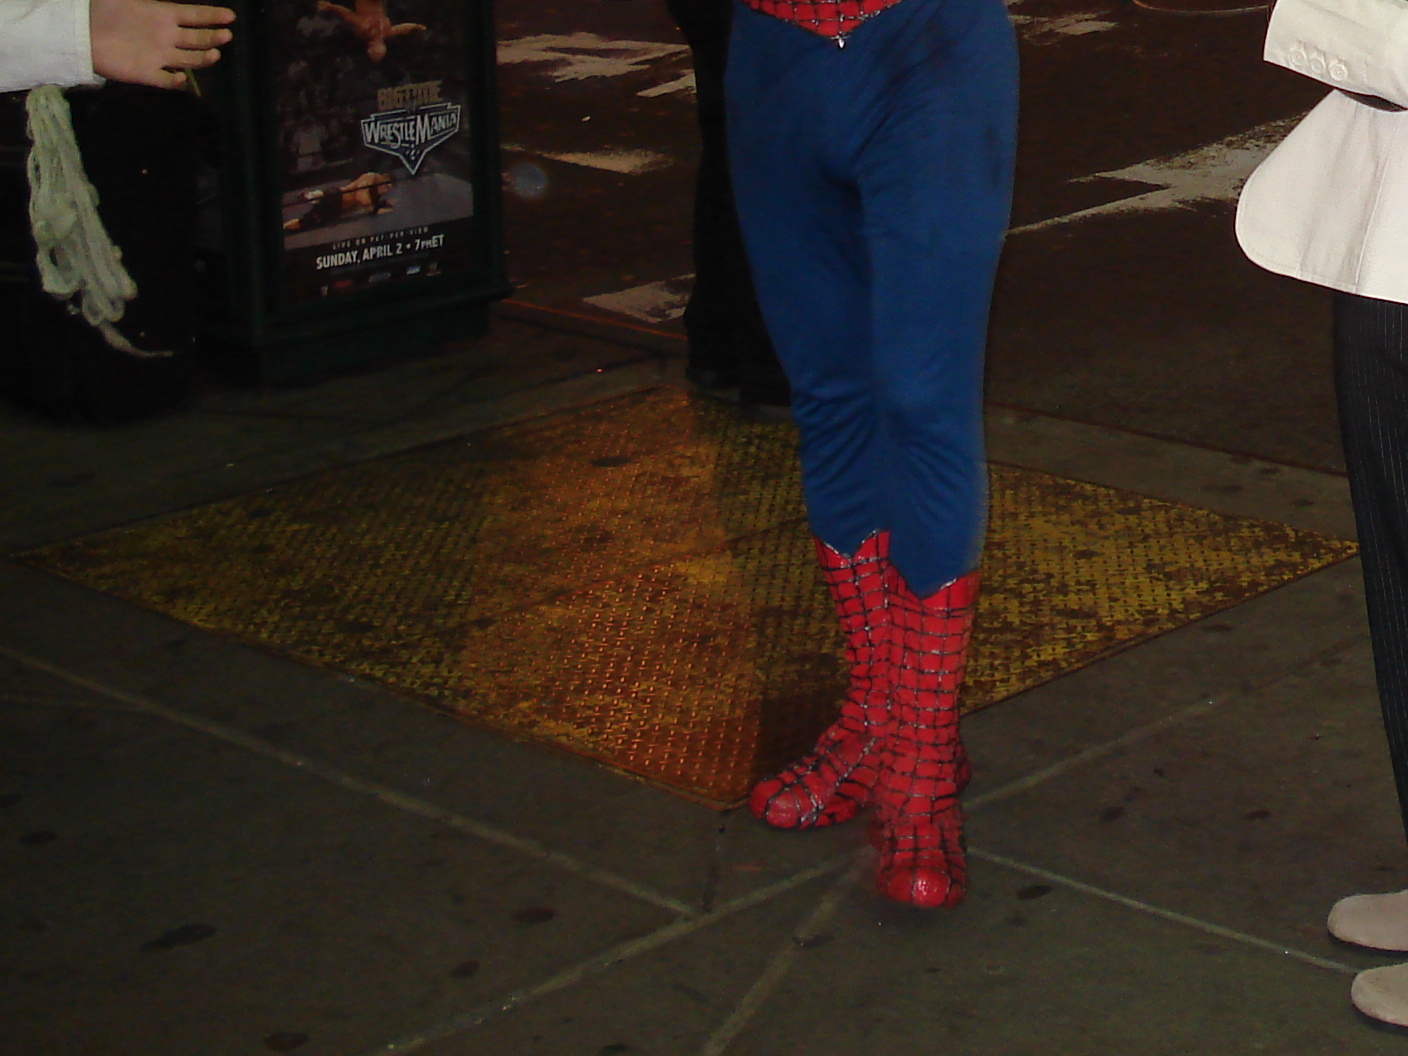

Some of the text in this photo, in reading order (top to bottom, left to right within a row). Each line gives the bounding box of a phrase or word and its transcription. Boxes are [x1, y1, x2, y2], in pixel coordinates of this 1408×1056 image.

[316, 250, 360, 270] SUNDAY,
[362, 245, 392, 261] APRIL
[395, 242, 403, 255] 2
